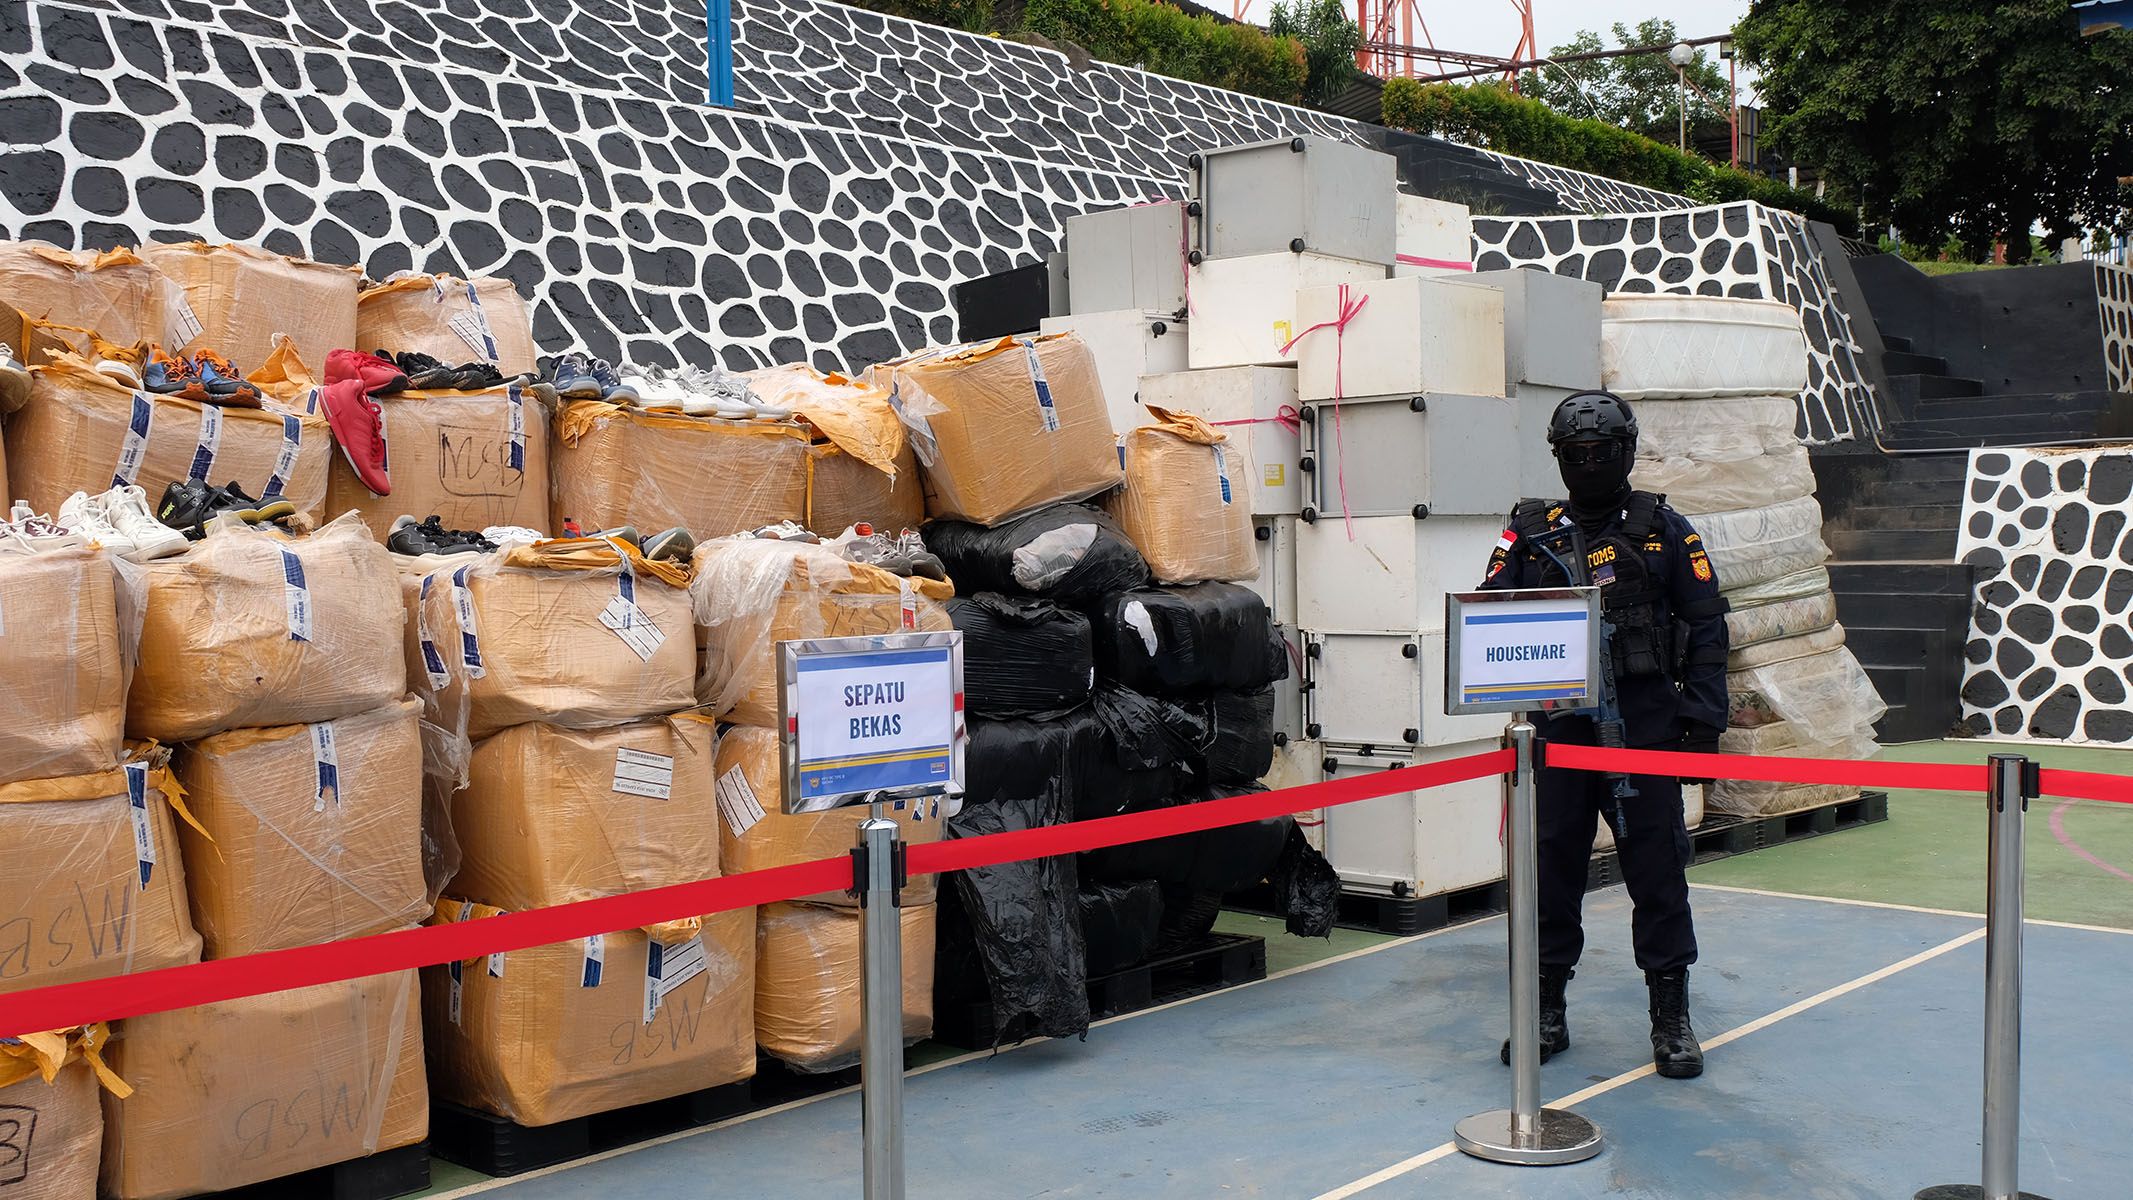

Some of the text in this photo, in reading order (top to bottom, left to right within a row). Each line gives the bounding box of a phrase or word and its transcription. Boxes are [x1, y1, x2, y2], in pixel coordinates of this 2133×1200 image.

[1486, 644, 1566, 663] HOUSEWARE
[844, 681, 905, 707] SEPATU
[850, 714, 902, 740] BEKAS
